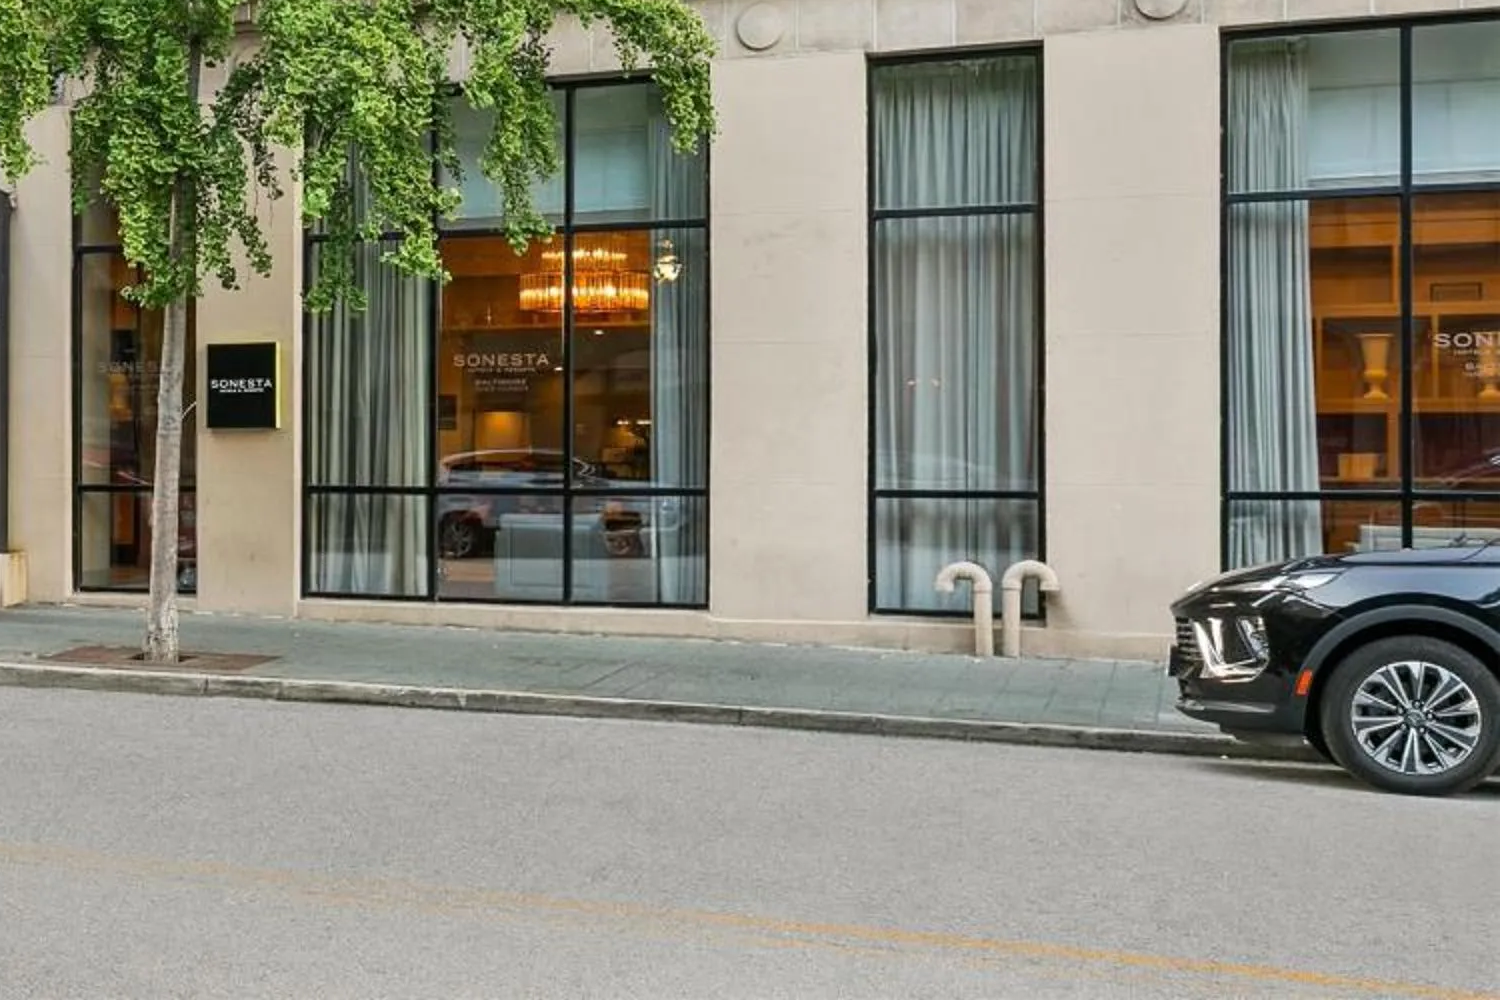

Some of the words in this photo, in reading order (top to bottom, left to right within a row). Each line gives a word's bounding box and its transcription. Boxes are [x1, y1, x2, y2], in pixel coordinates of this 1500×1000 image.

[1434, 333, 1500, 348] SON
[453, 353, 549, 367] SONESTA
[211, 379, 273, 389] SONESTA
